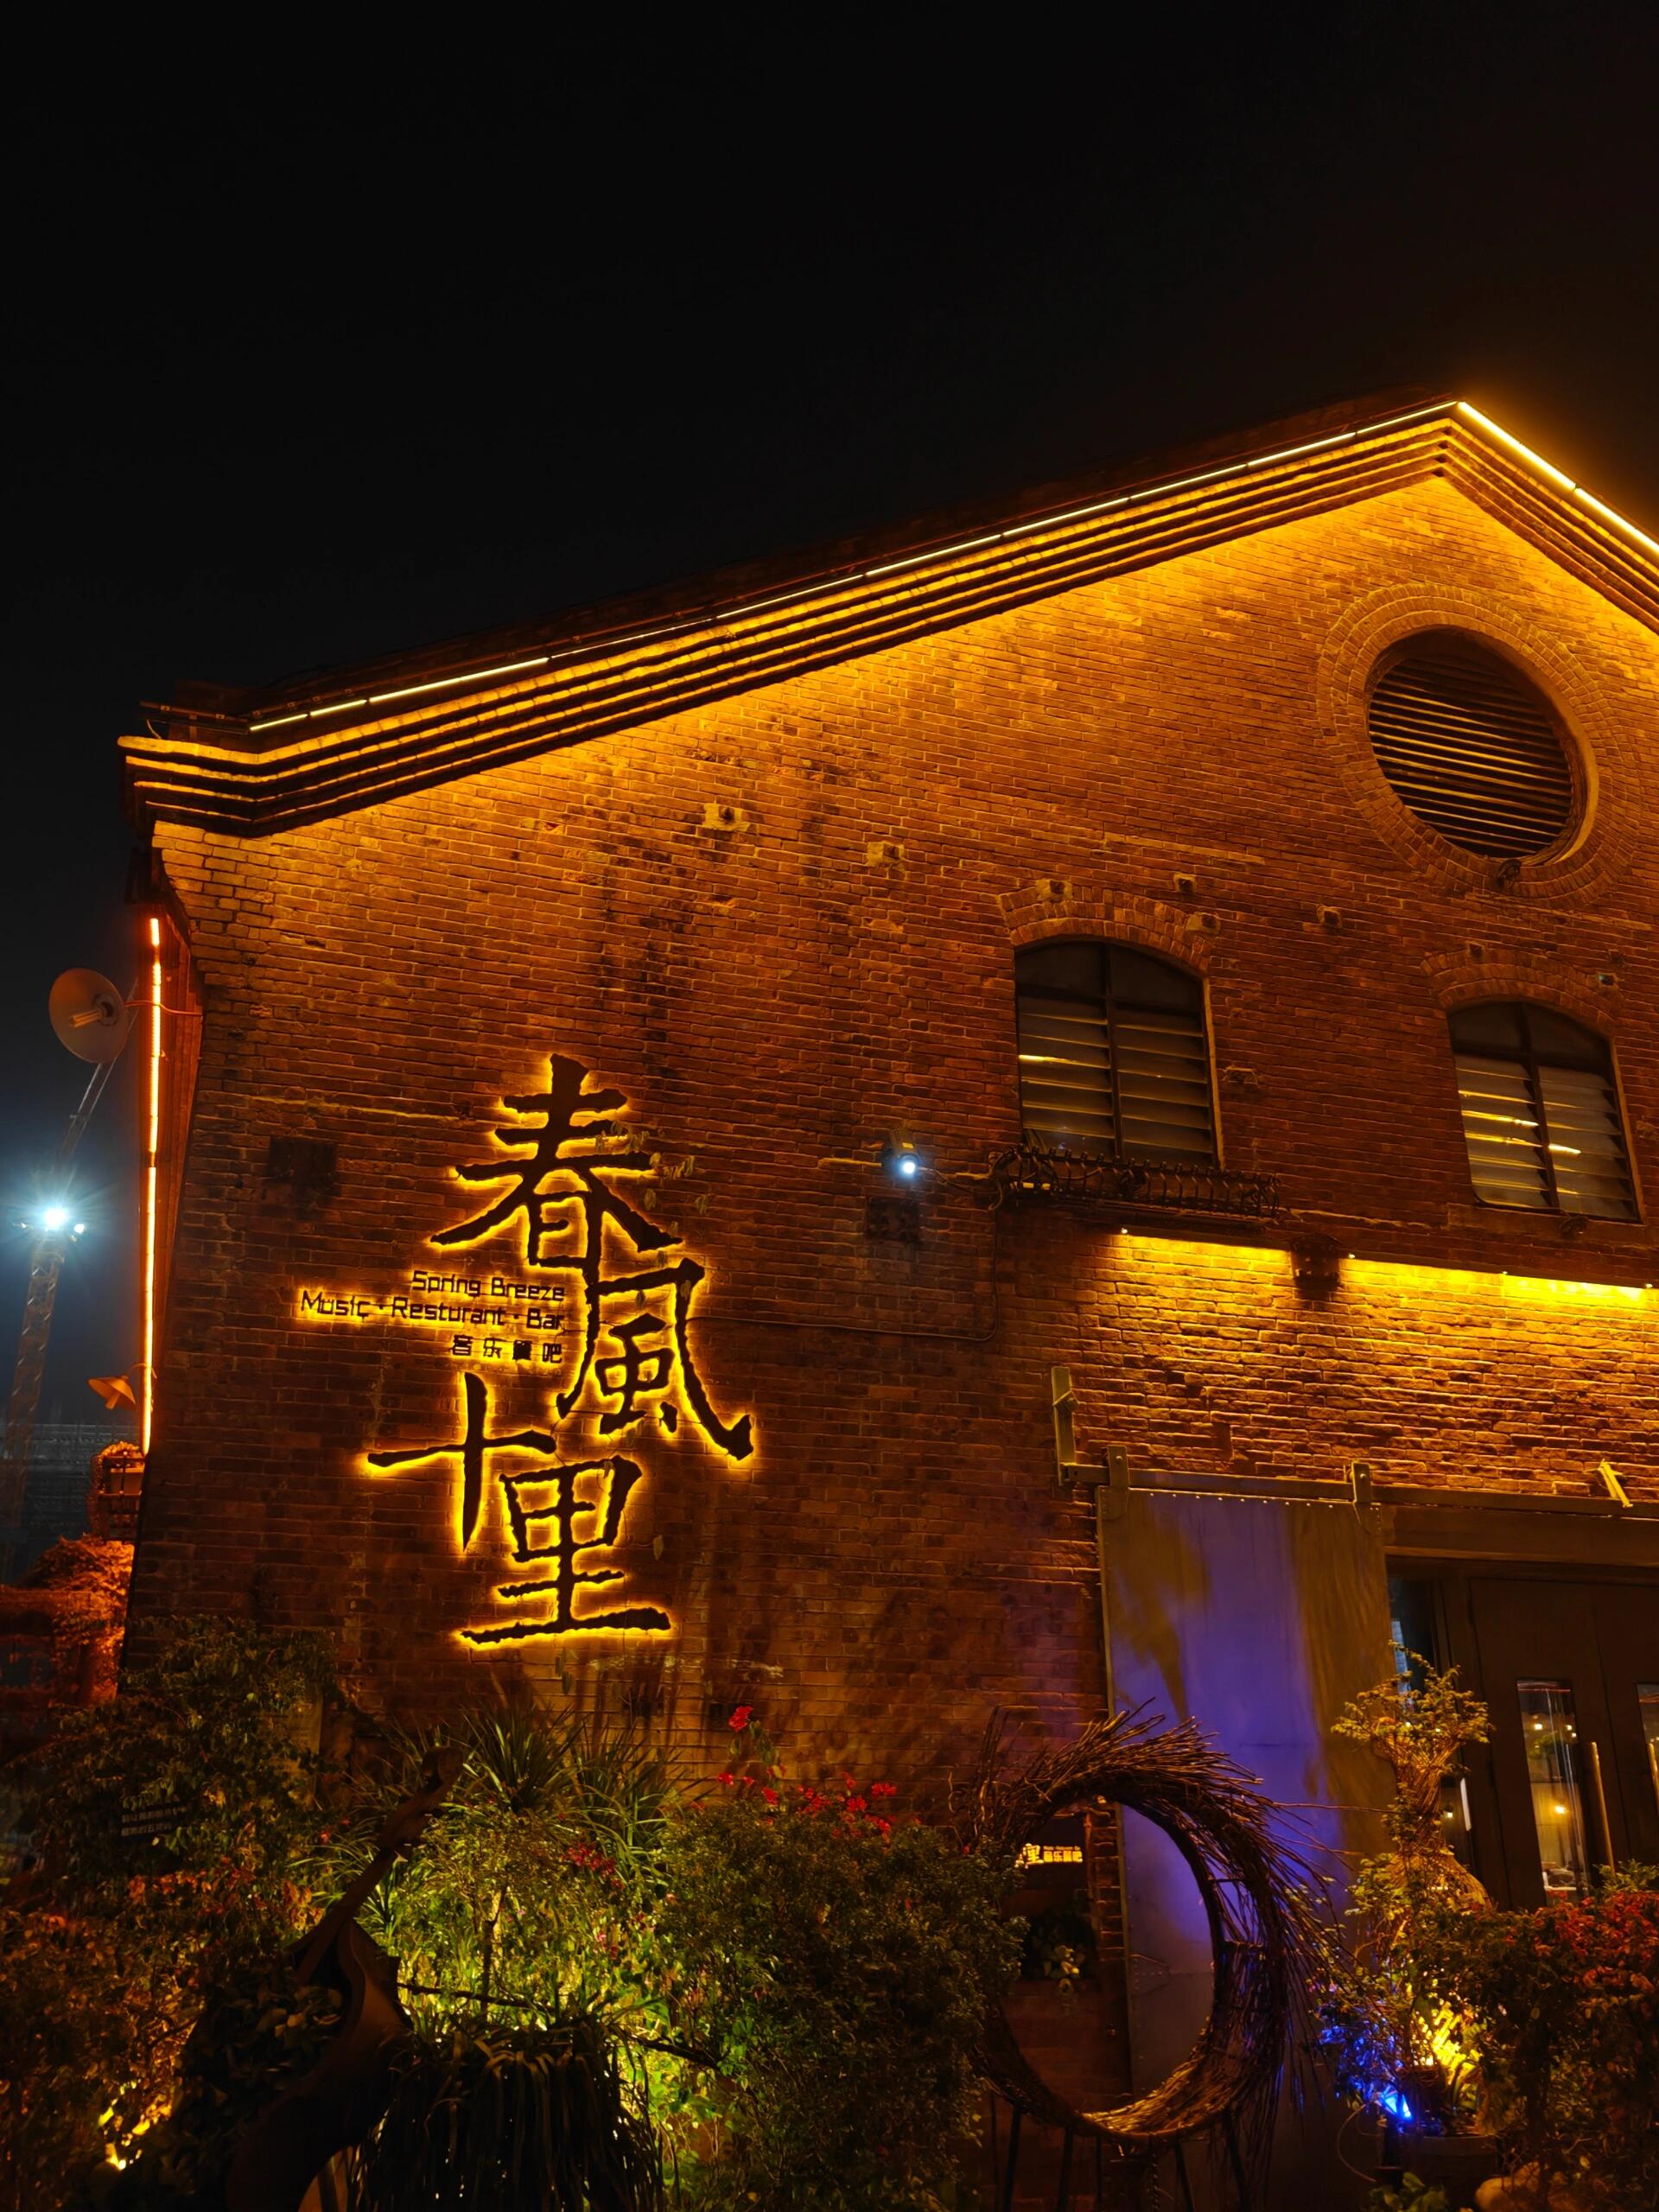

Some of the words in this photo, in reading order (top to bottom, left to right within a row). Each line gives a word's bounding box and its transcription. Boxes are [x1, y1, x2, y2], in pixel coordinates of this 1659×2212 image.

[412, 1270, 480, 1297] Spring
[492, 1277, 564, 1301] Breeze
[302, 1290, 370, 1318] Music
[391, 1297, 506, 1325] Resturant
[526, 1307, 565, 1329] Bar
